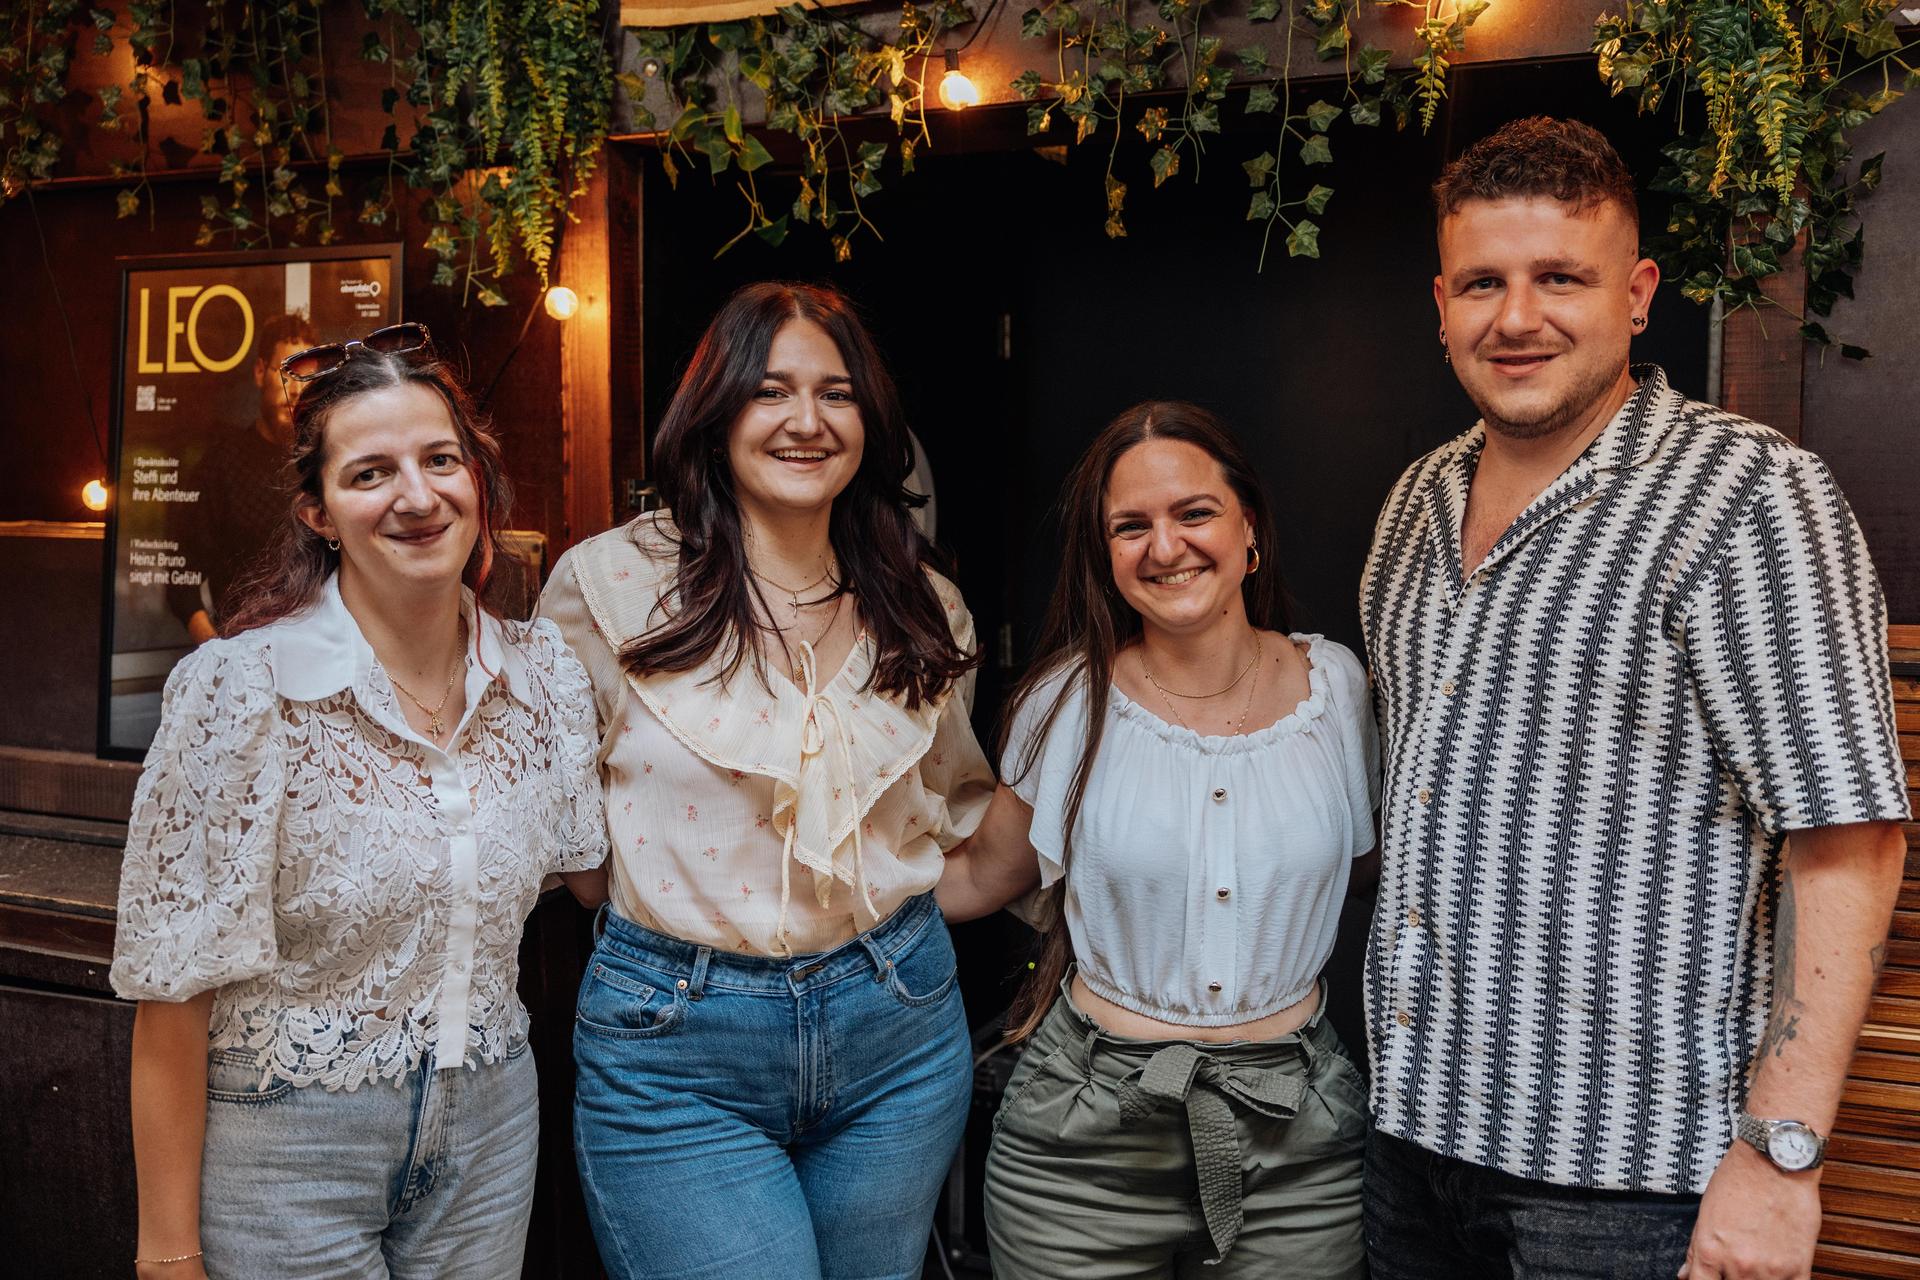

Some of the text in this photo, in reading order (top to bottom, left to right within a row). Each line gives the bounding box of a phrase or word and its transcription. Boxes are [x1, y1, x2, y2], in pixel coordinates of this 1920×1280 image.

[138, 284, 255, 374] LEO
[160, 471, 178, 485] und
[152, 488, 200, 503] Abenteuer
[129, 552, 186, 568] Heinz Bruno
[129, 570, 202, 587] singt mit Gefühl
